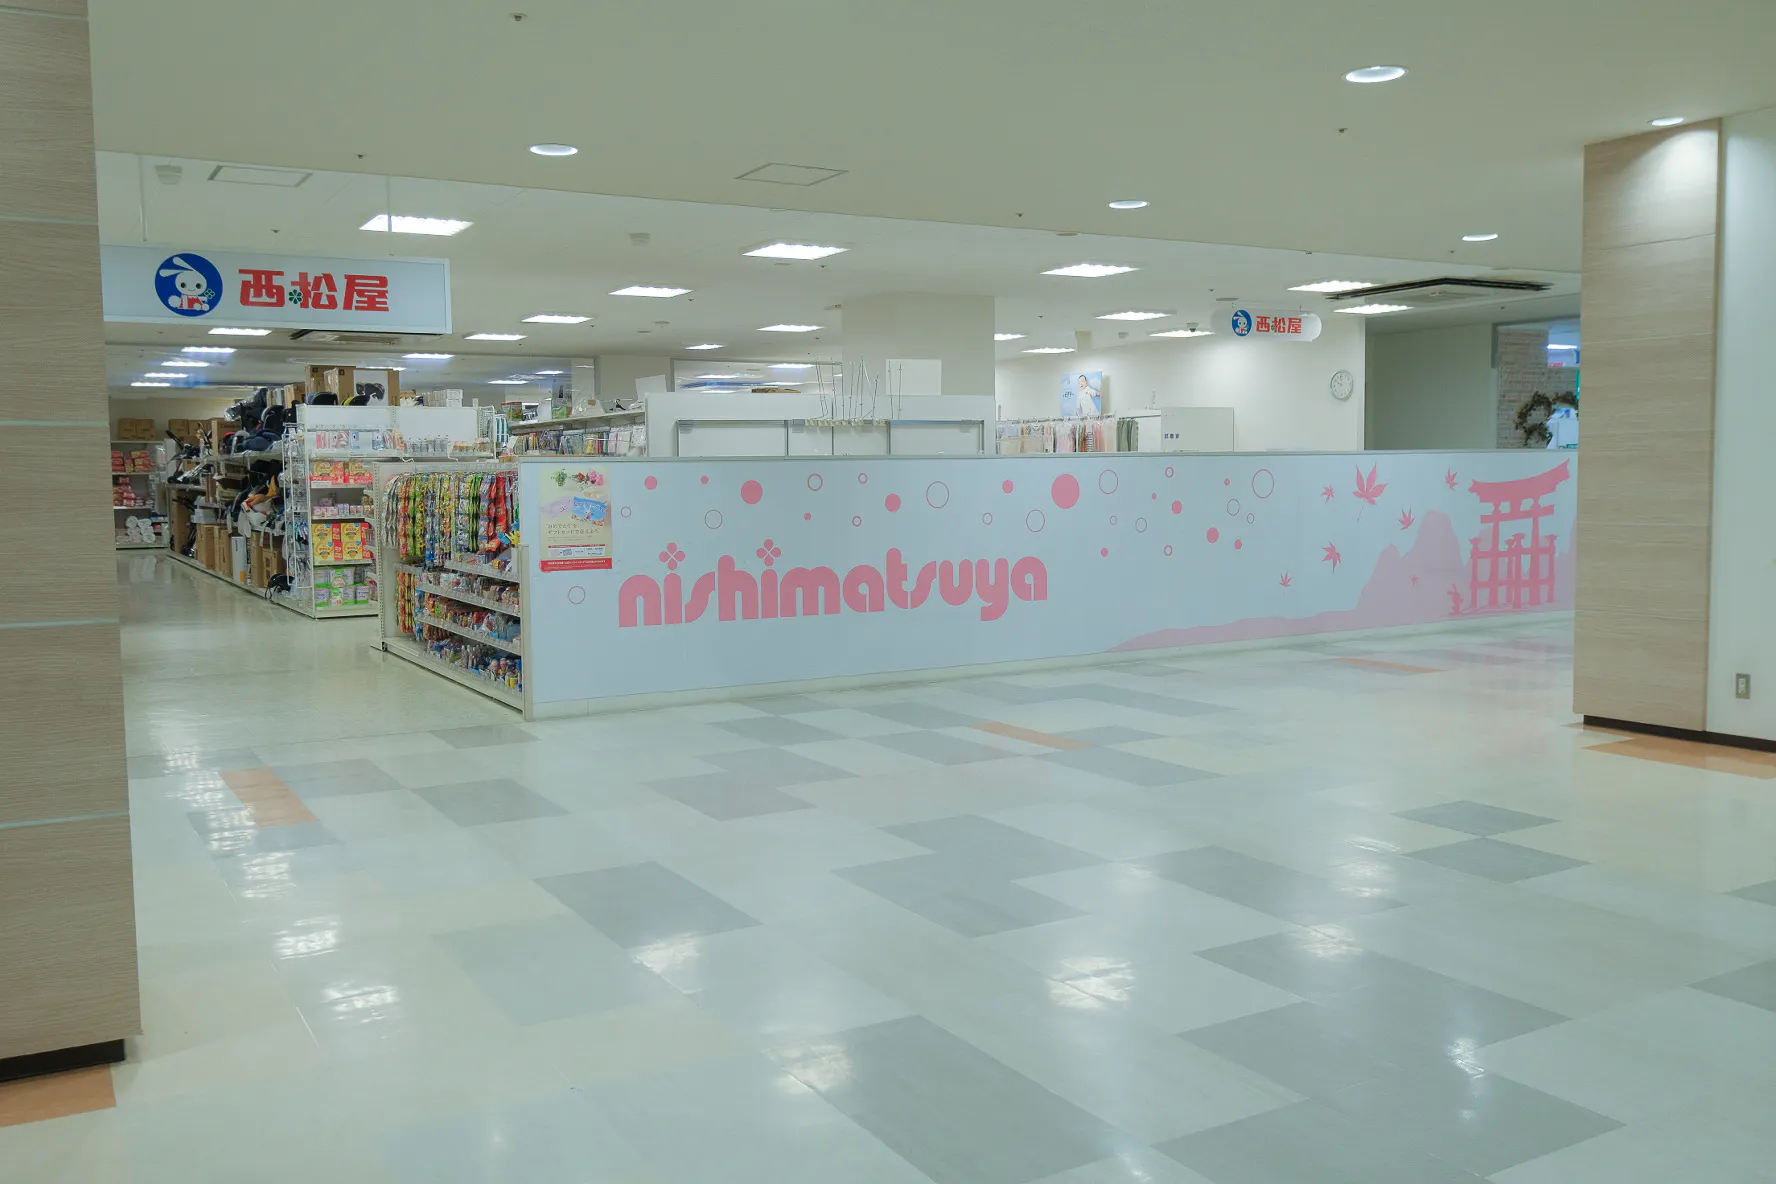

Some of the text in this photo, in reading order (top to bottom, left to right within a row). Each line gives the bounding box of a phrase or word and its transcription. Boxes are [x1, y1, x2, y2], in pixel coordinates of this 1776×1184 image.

[238, 268, 390, 312] 西松屋
[1256, 315, 1303, 334] 西松屋
[618, 539, 1048, 628] nishimatsuya
